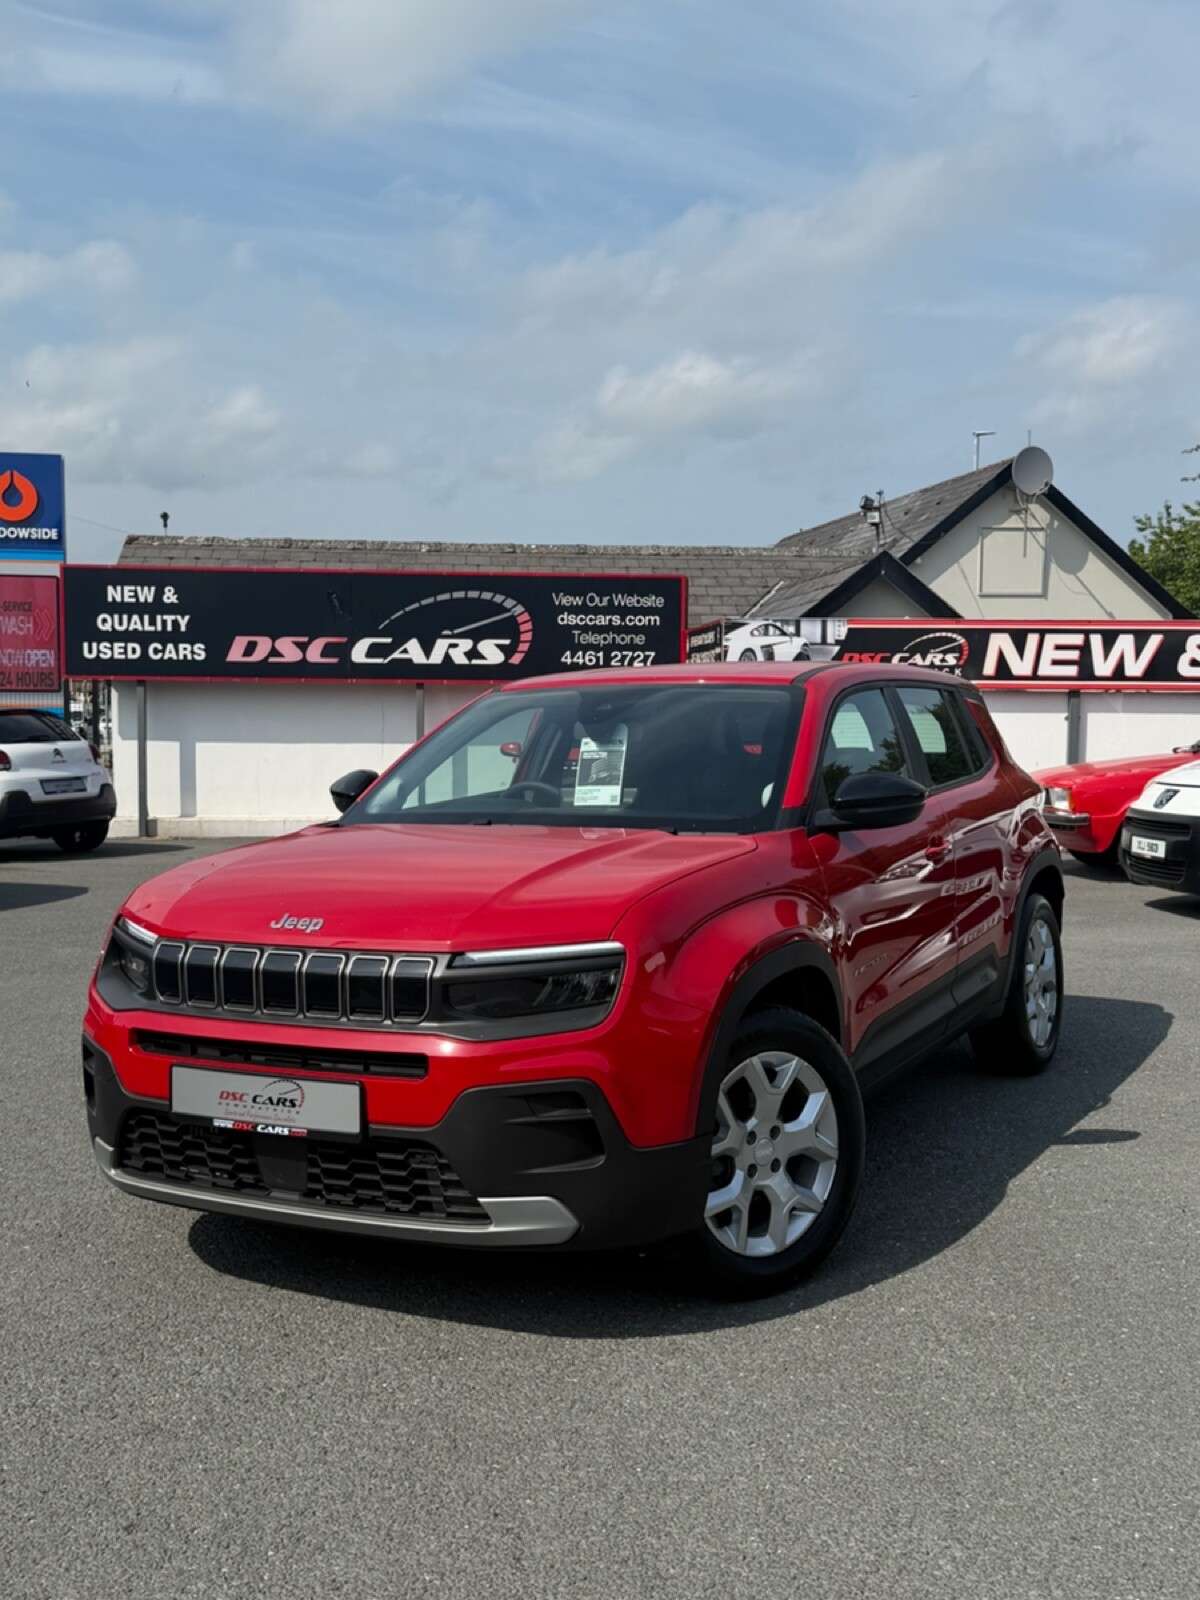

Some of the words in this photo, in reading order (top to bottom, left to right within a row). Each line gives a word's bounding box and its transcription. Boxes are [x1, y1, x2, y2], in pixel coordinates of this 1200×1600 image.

[106, 585, 156, 602] NEW
[162, 586, 179, 603] &
[551, 592, 585, 607] View
[586, 592, 610, 607] Our
[612, 593, 665, 607] Website
[96, 613, 191, 632] QUALITY
[557, 611, 661, 626] dsccars.com
[572, 630, 646, 647] Telephone
[82, 641, 141, 660] USED
[147, 642, 206, 661] CARS
[226, 635, 348, 664] DSC
[350, 637, 512, 665] CARS
[560, 650, 604, 666] 4461
[610, 651, 656, 668] 2727
[891, 652, 960, 666] CARS
[982, 633, 1164, 677] NEW
[15, 672, 55, 689] HOURS
[270, 912, 324, 934] Jeep
[219, 1090, 250, 1103] DSC
[252, 1094, 299, 1109] CARS
